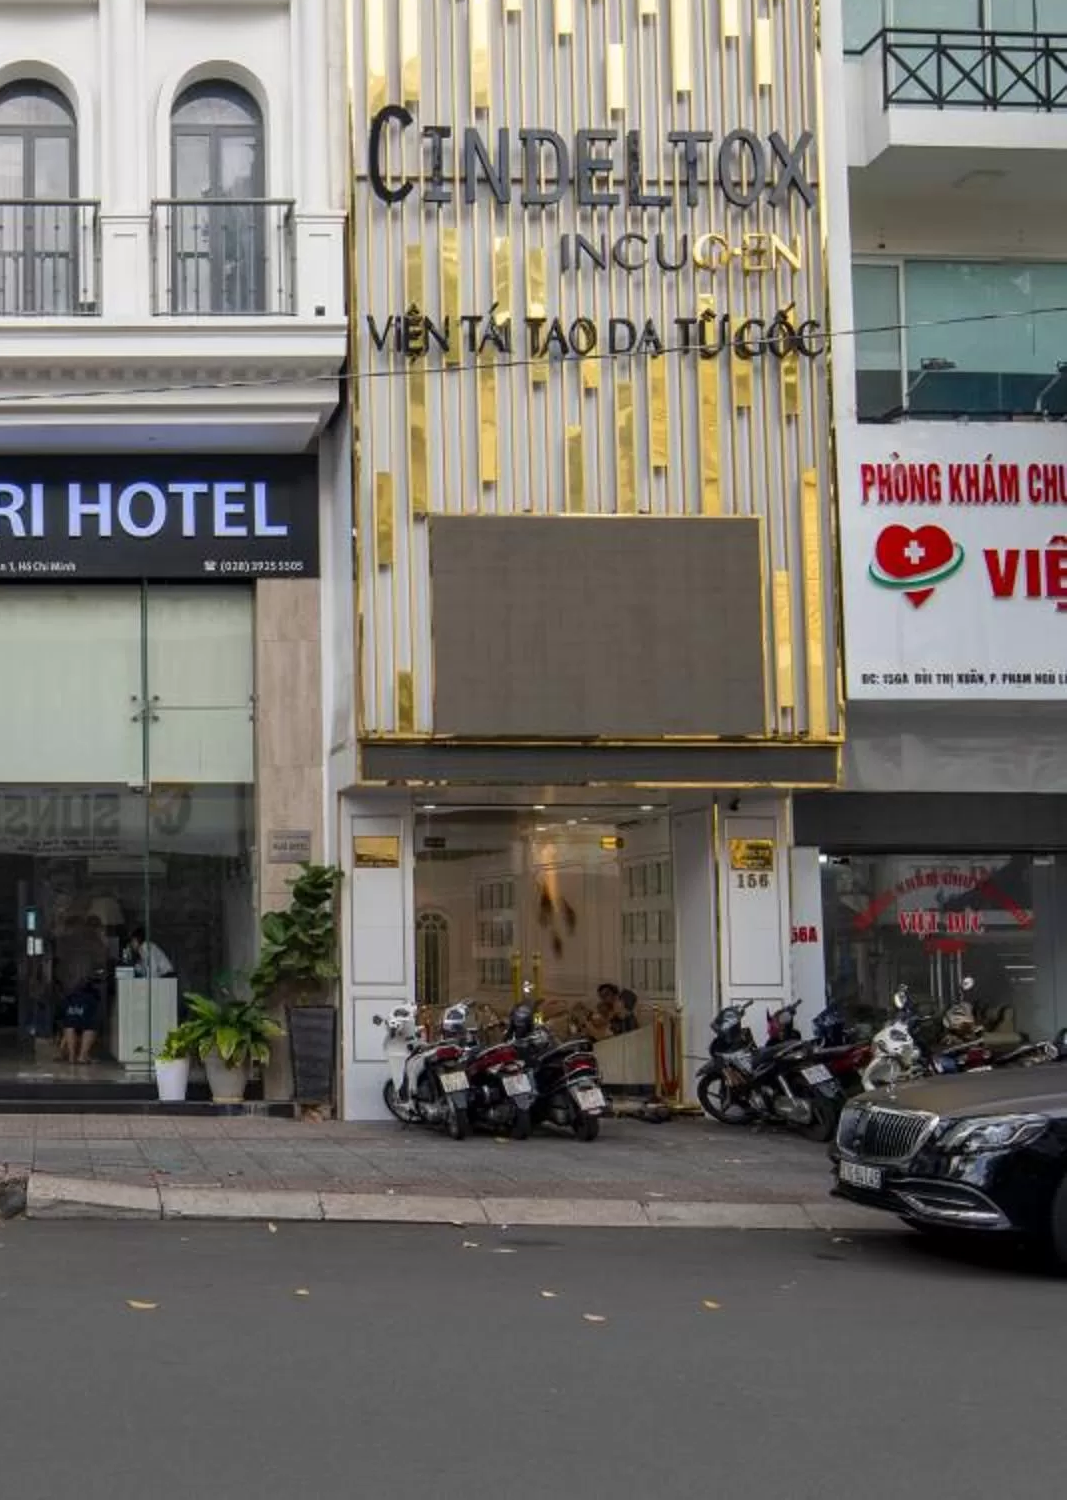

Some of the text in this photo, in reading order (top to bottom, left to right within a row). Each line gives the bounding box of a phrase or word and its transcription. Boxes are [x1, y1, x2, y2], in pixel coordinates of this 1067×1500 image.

[369, 104, 814, 209] CINDELTOX
[366, 303, 450, 363] VIỆN
[460, 302, 511, 354] TÁI
[609, 318, 664, 358] DA
[734, 301, 824, 360] GỐC
[861, 451, 941, 504] PHÒNG
[948, 453, 1019, 504] KHÁM
[68, 481, 288, 537] HOTEL
[737, 873, 769, 889] 156
